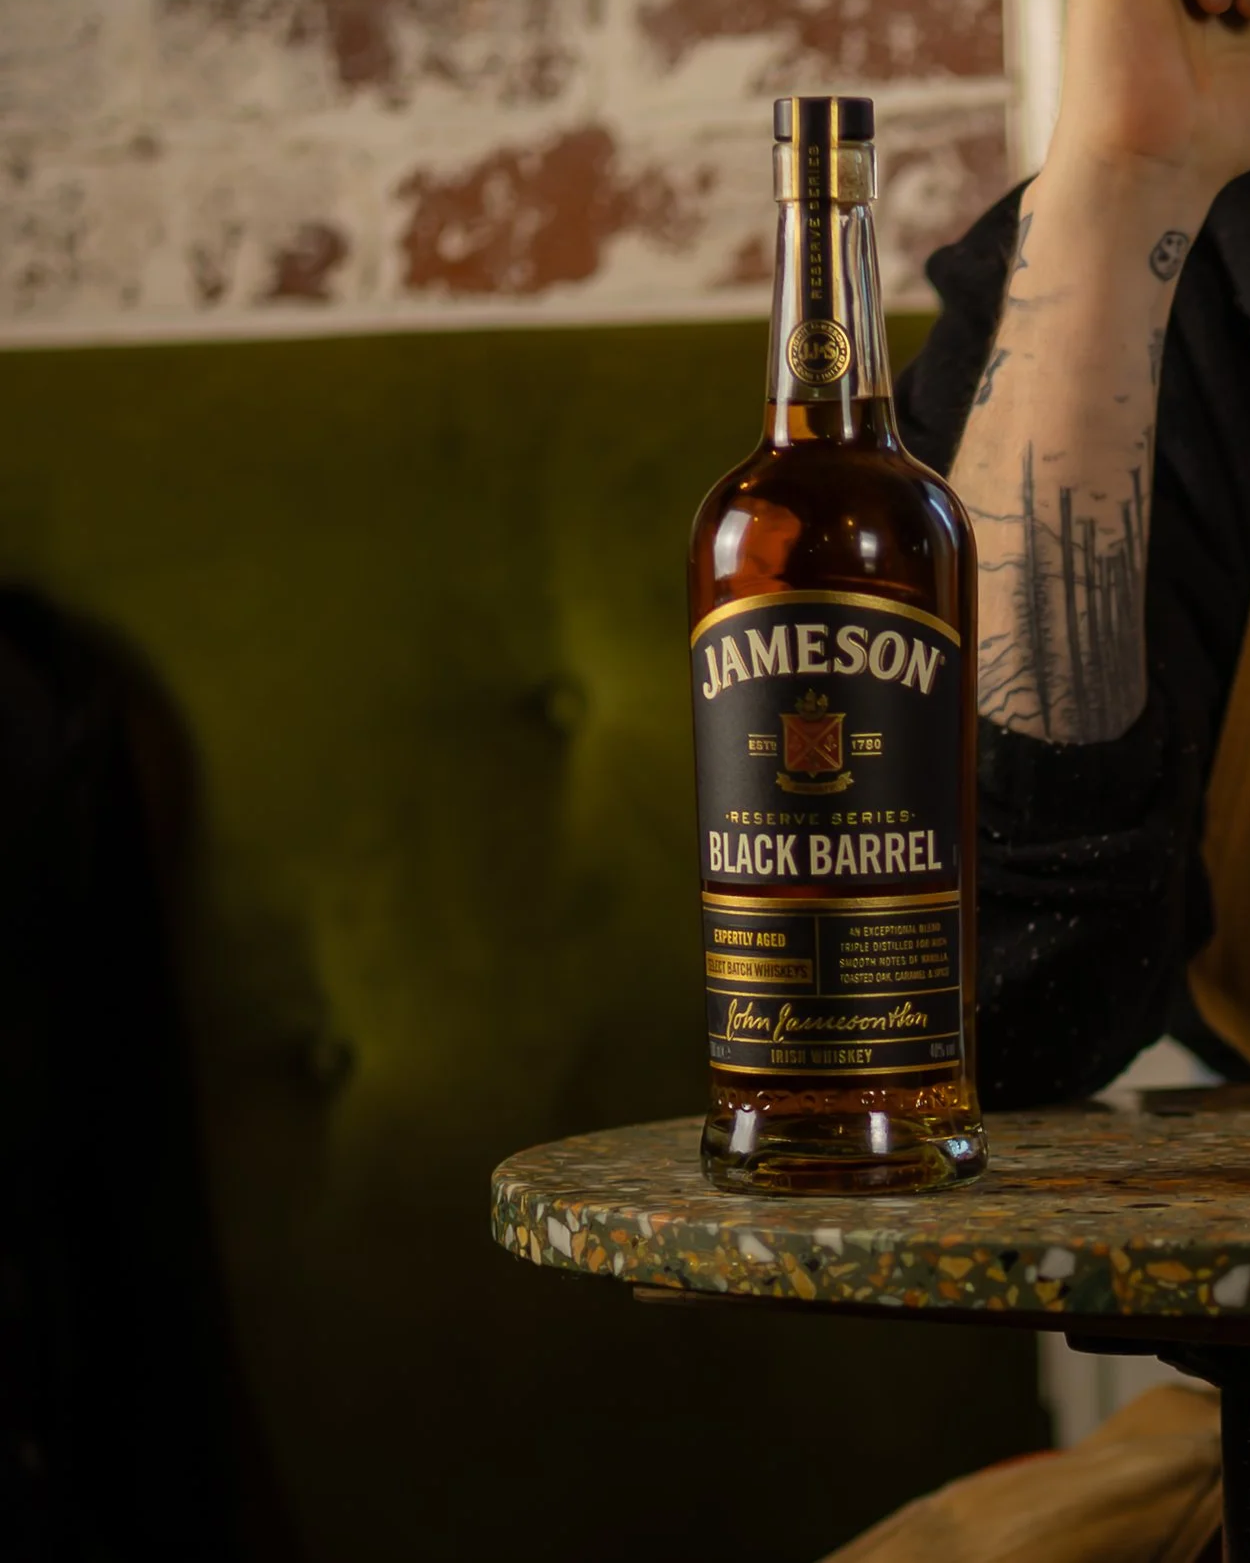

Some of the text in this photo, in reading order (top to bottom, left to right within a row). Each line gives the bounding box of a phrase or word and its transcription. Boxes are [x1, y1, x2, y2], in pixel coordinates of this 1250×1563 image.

[702, 623, 942, 700] JAMESON
[851, 739, 882, 750] 1780
[730, 810, 910, 825] RESERVE SERIES
[709, 830, 942, 876] BLACK BARREL
[714, 928, 786, 947] EXPERTLY AGED
[727, 961, 752, 976] BATCH
[770, 1048, 872, 1064] IRISH WHISKEY
